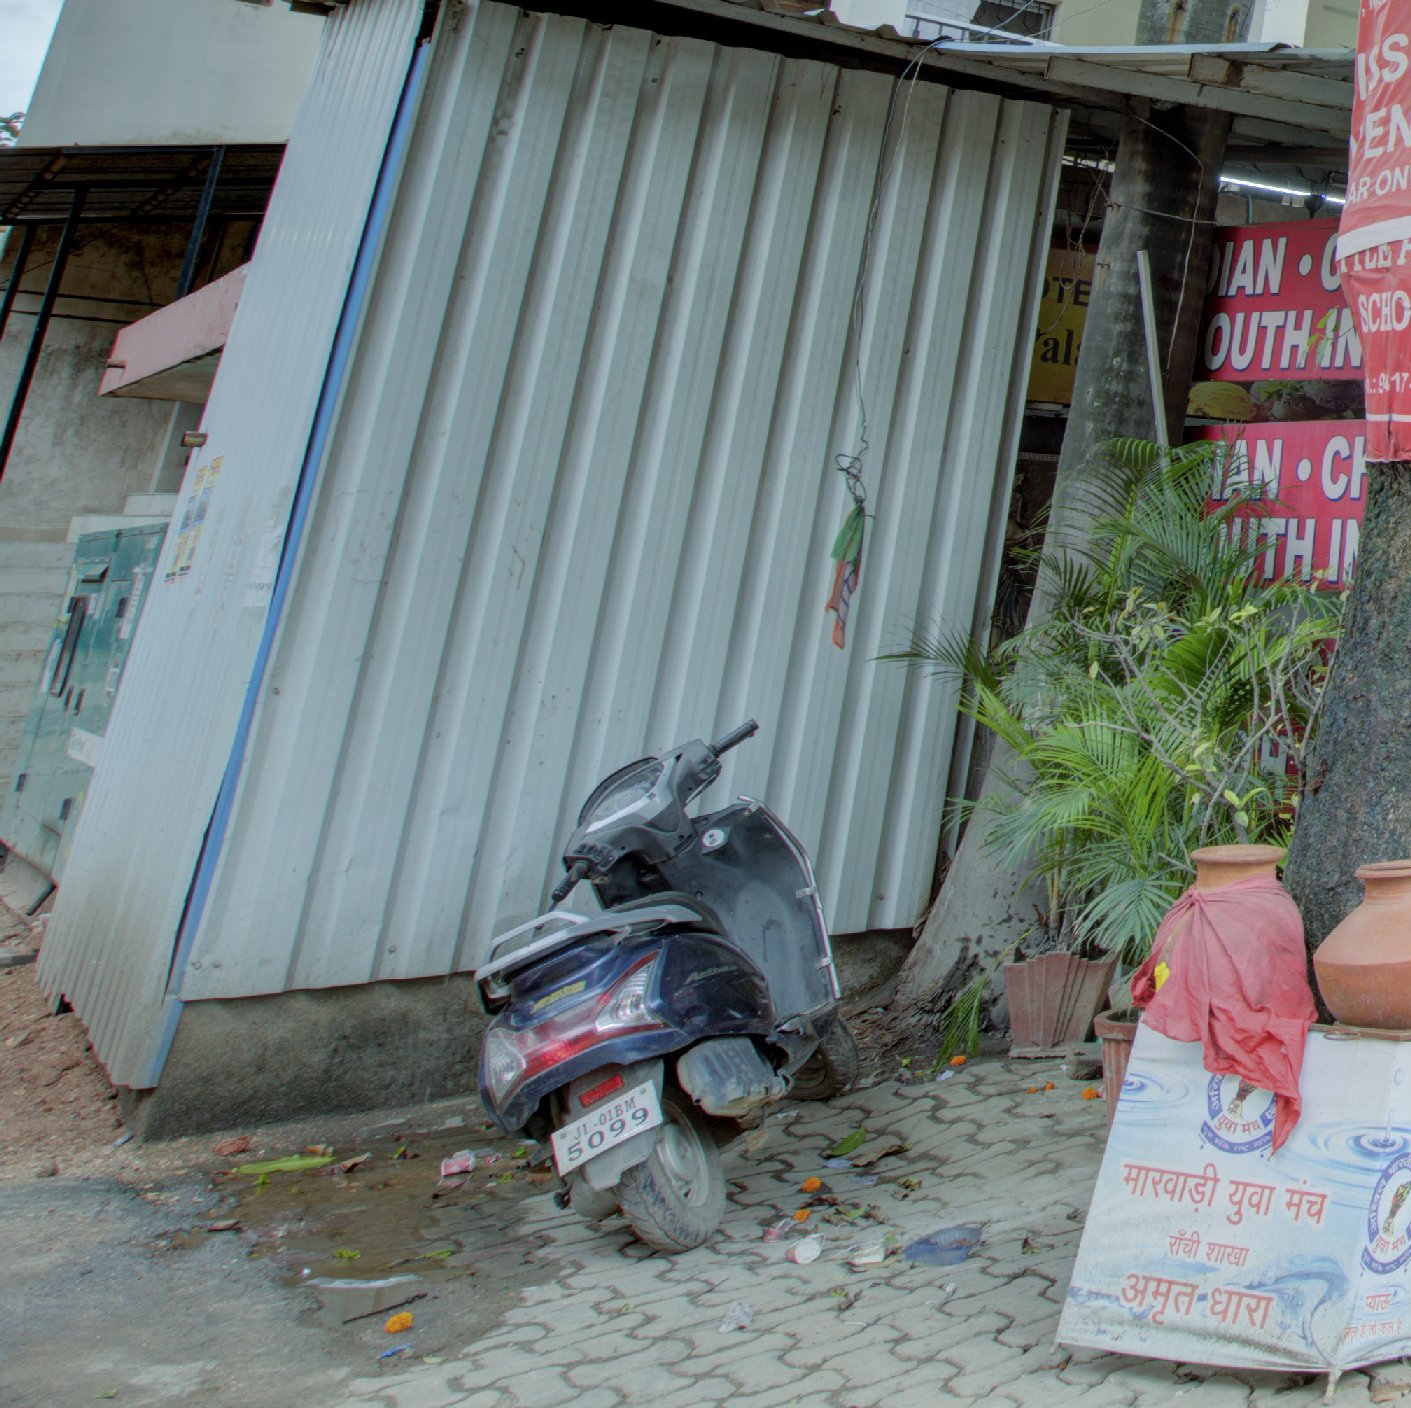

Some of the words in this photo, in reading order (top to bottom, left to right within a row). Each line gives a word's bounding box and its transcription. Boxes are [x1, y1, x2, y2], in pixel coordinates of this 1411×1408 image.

[567, 1107, 650, 1162] 5099
[1124, 1162, 1221, 1213] मारवाड़ी
[1226, 1179, 1277, 1225] युवा
[1284, 1179, 1328, 1224] मंच
[1205, 1241, 1251, 1267] शाखा
[1121, 1273, 1200, 1326] अमृत
[1210, 1287, 1275, 1330] धारा
